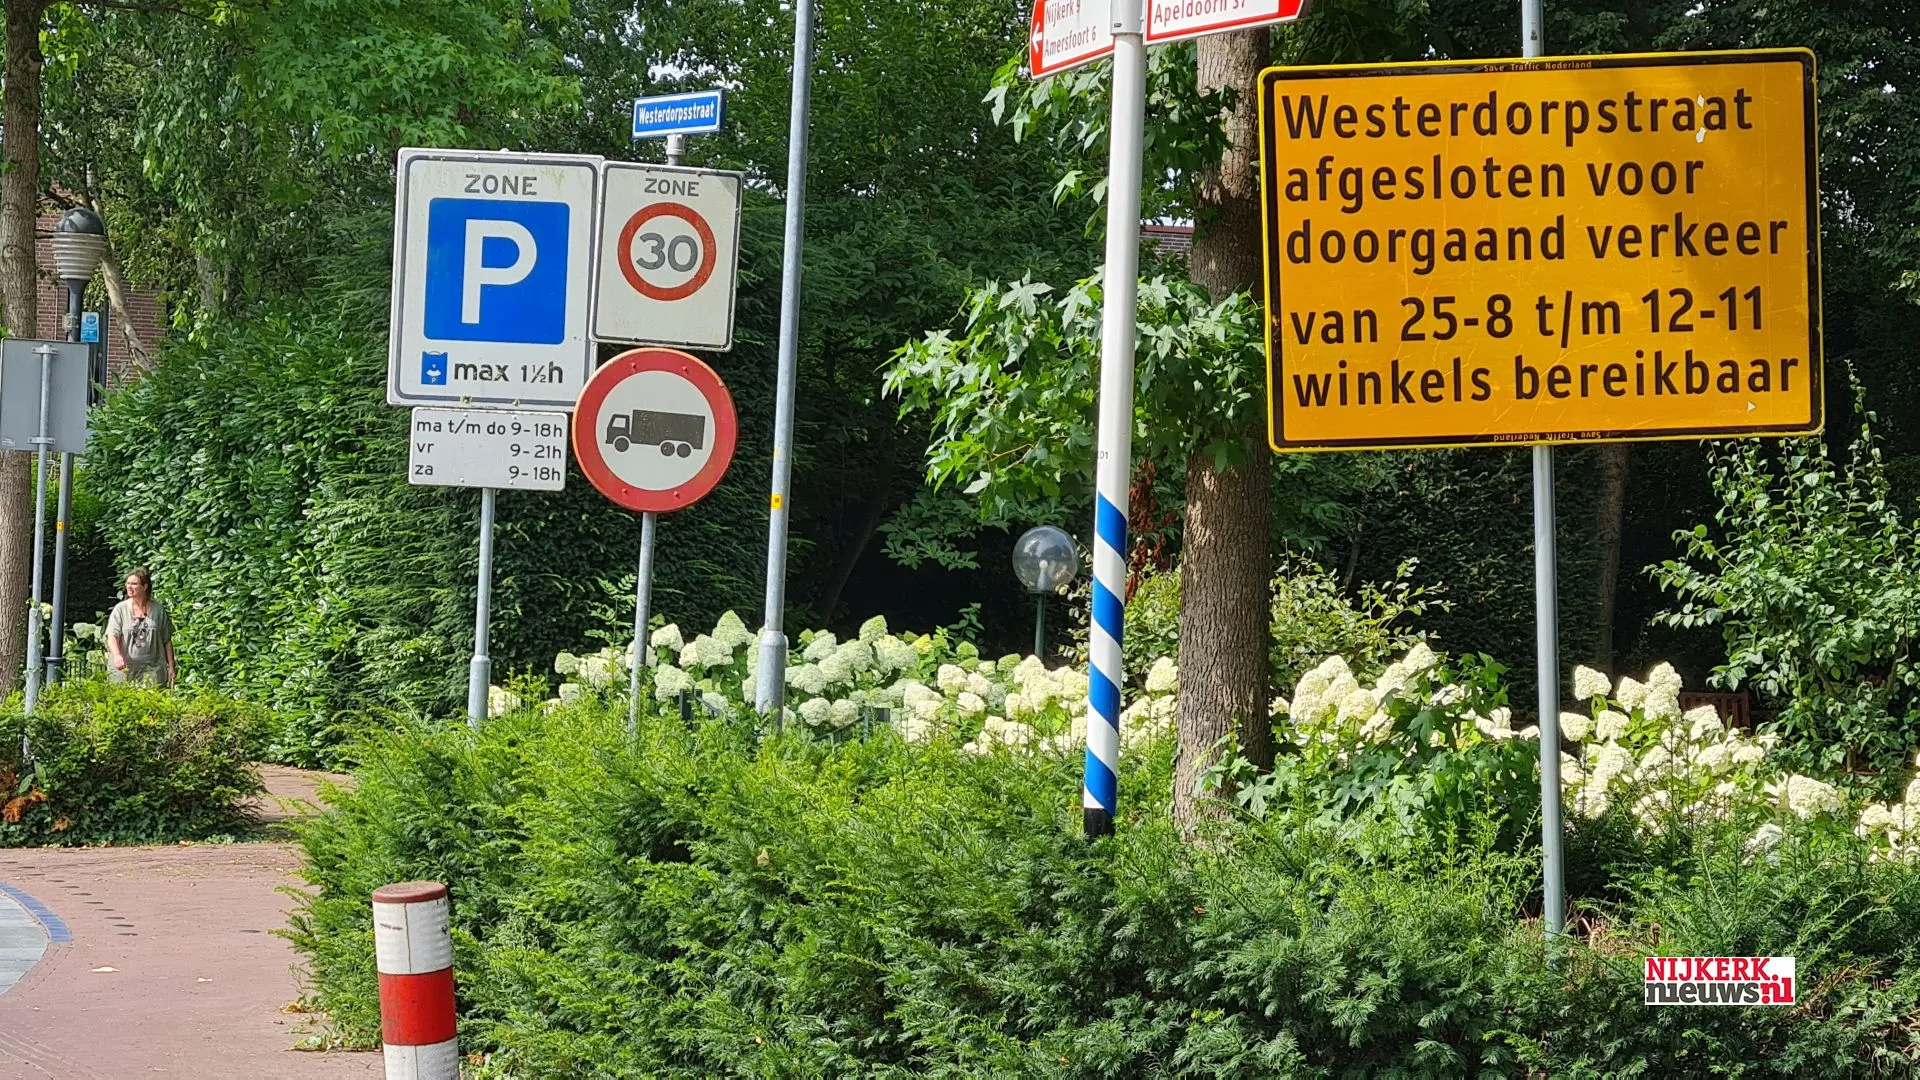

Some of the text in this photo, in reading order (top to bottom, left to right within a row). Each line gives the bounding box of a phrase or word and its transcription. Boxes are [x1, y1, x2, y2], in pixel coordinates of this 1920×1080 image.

[1045, 0, 1074, 27] Nijkerk
[1153, 0, 1228, 27] Apeldoorn
[1044, 25, 1097, 58] Amersfoort 6
[1483, 60, 1593, 72] Save Traffic Nederland
[639, 100, 714, 124] Westerdorpsstraat
[1281, 87, 1753, 148] Westerdorpstraat
[464, 174, 538, 196] ZONE
[644, 177, 700, 197] ZONE
[1285, 154, 1704, 214] afgesloten voor
[635, 232, 698, 273] 30
[1286, 211, 1788, 276] doorgaand verkeer
[461, 218, 538, 325] P
[1290, 285, 1762, 349] van 25-8 t/m 12-11
[454, 362, 510, 382] max
[1293, 349, 1799, 408] winkels bereikbaar
[416, 421, 442, 433] ma
[448, 419, 481, 434] t/m
[486, 422, 506, 435] do
[1493, 431, 1602, 443] Save Traffic Nederland
[416, 442, 434, 454] vr
[414, 464, 434, 476] za
